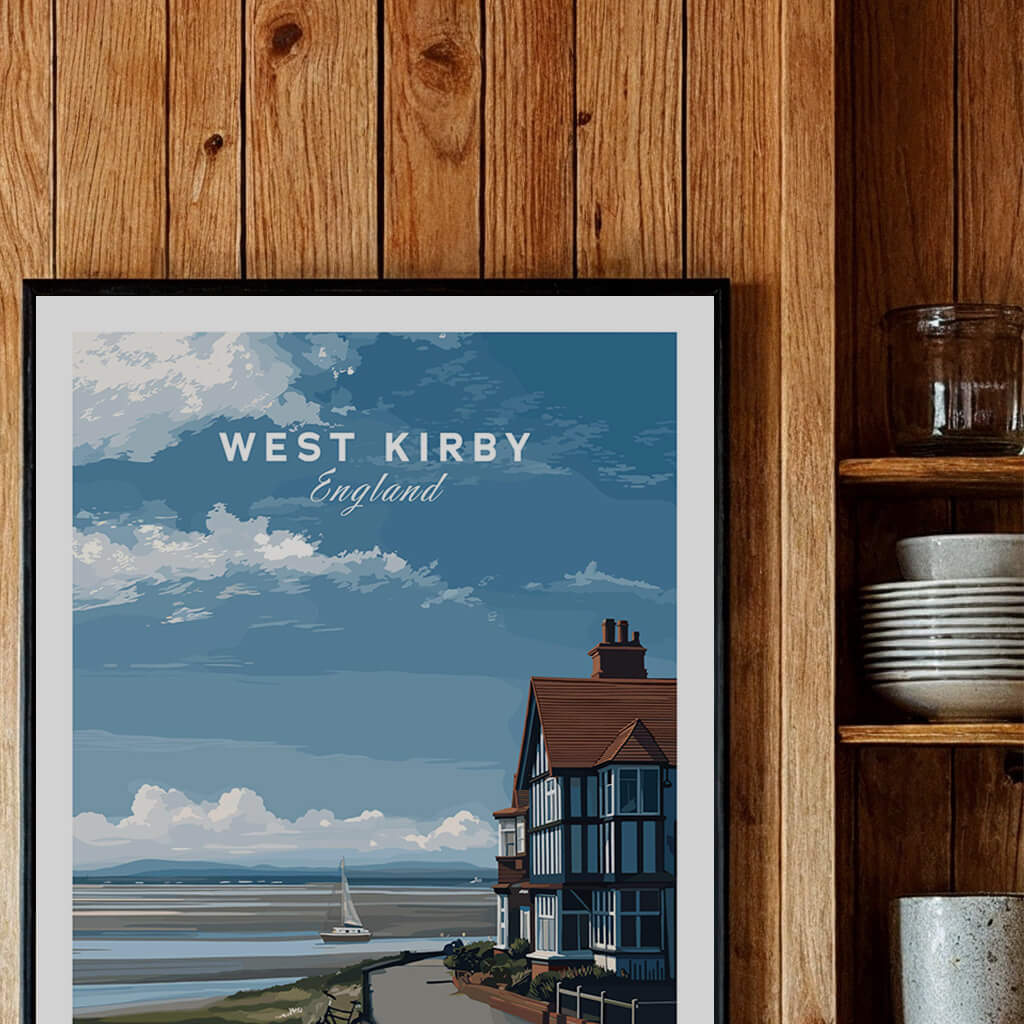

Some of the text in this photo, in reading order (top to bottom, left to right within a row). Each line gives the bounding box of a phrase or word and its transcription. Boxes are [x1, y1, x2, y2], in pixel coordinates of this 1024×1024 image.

[219, 432, 531, 462] WEST KIRBY
[309, 467, 448, 517] England
